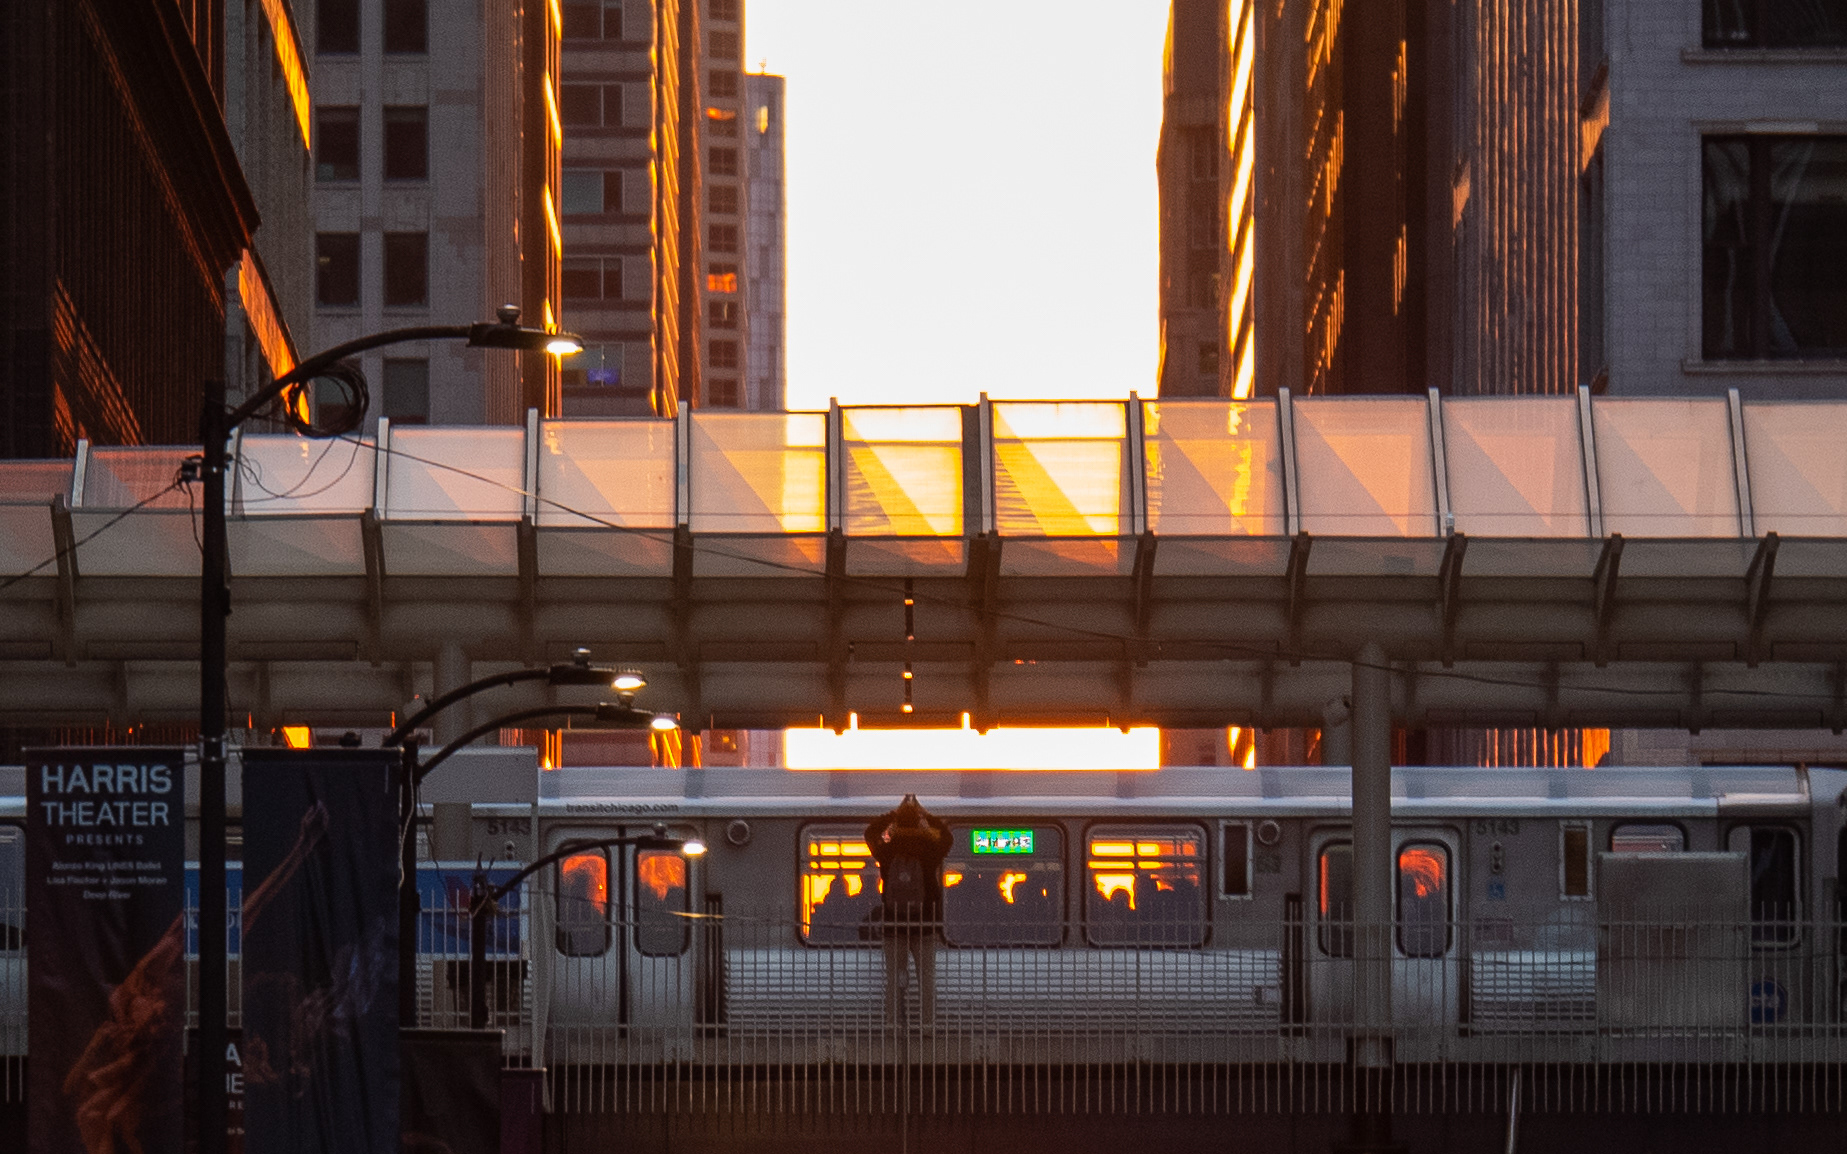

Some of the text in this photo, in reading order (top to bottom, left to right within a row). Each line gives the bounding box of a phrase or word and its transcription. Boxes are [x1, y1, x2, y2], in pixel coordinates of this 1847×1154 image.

[41, 764, 173, 794] HARRIS
[41, 801, 170, 826] THEATER
[565, 803, 680, 815] transitchicago.com
[487, 819, 531, 835] 5143
[1476, 821, 1519, 835] 5143
[65, 833, 144, 845] PRESENTS
